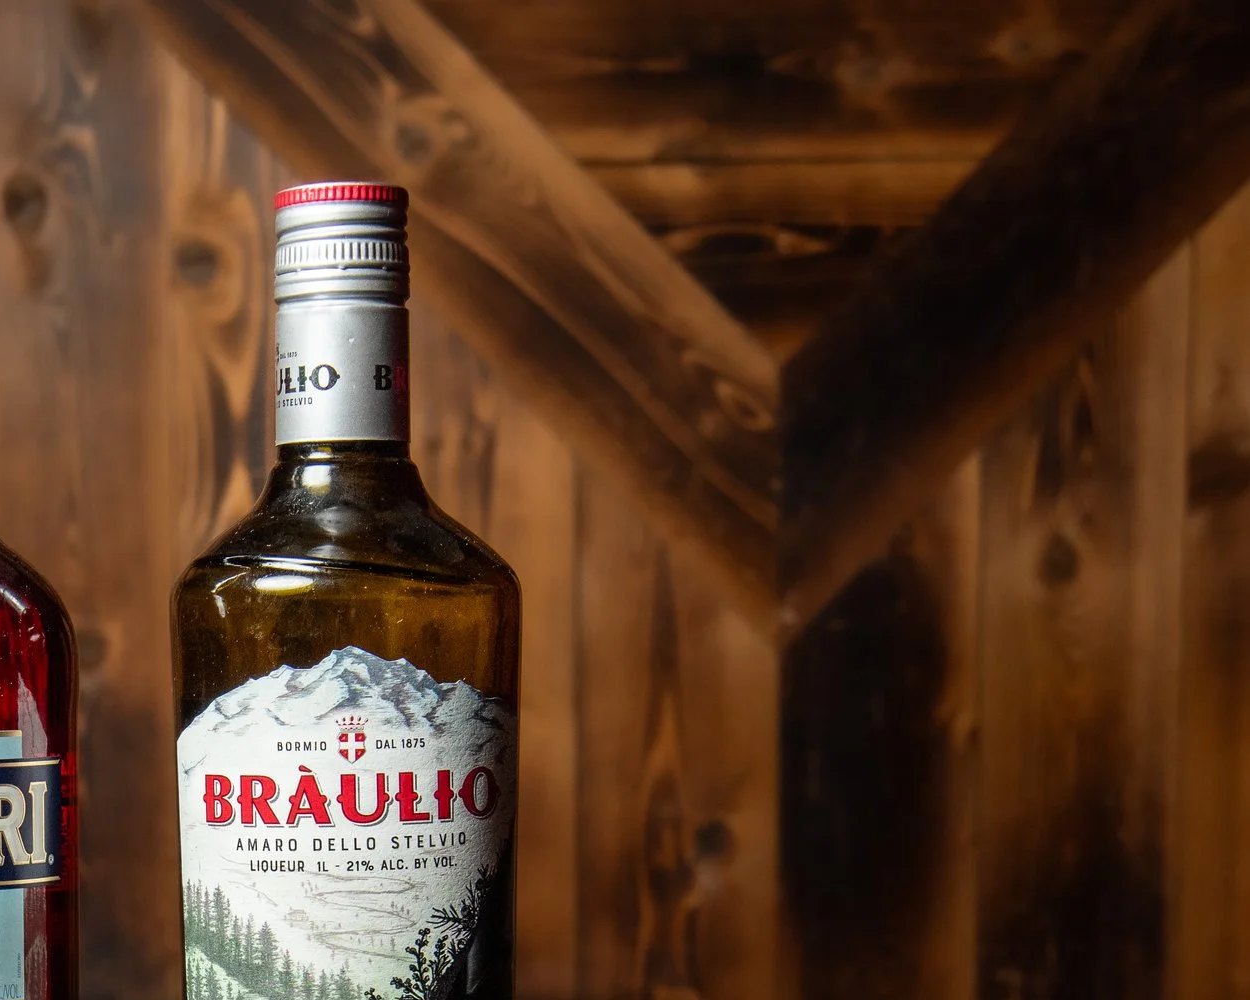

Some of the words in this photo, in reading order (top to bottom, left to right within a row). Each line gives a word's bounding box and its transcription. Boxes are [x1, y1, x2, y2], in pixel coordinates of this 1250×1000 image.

[282, 396, 313, 408] STELVIO
[277, 740, 327, 752] BORMIO
[375, 738, 397, 750] DAL
[401, 737, 426, 749] 1875
[202, 764, 500, 826] BRÀULIO
[236, 837, 298, 852] AMARO
[313, 836, 376, 852] DELLO
[391, 831, 467, 850] STELVIO
[250, 859, 305, 873] LIQUEUR
[317, 861, 329, 873] 1L
[346, 860, 375, 873] 21%
[381, 859, 409, 872] ALC.
[414, 857, 428, 870] BY
[433, 855, 458, 869] VOL.
